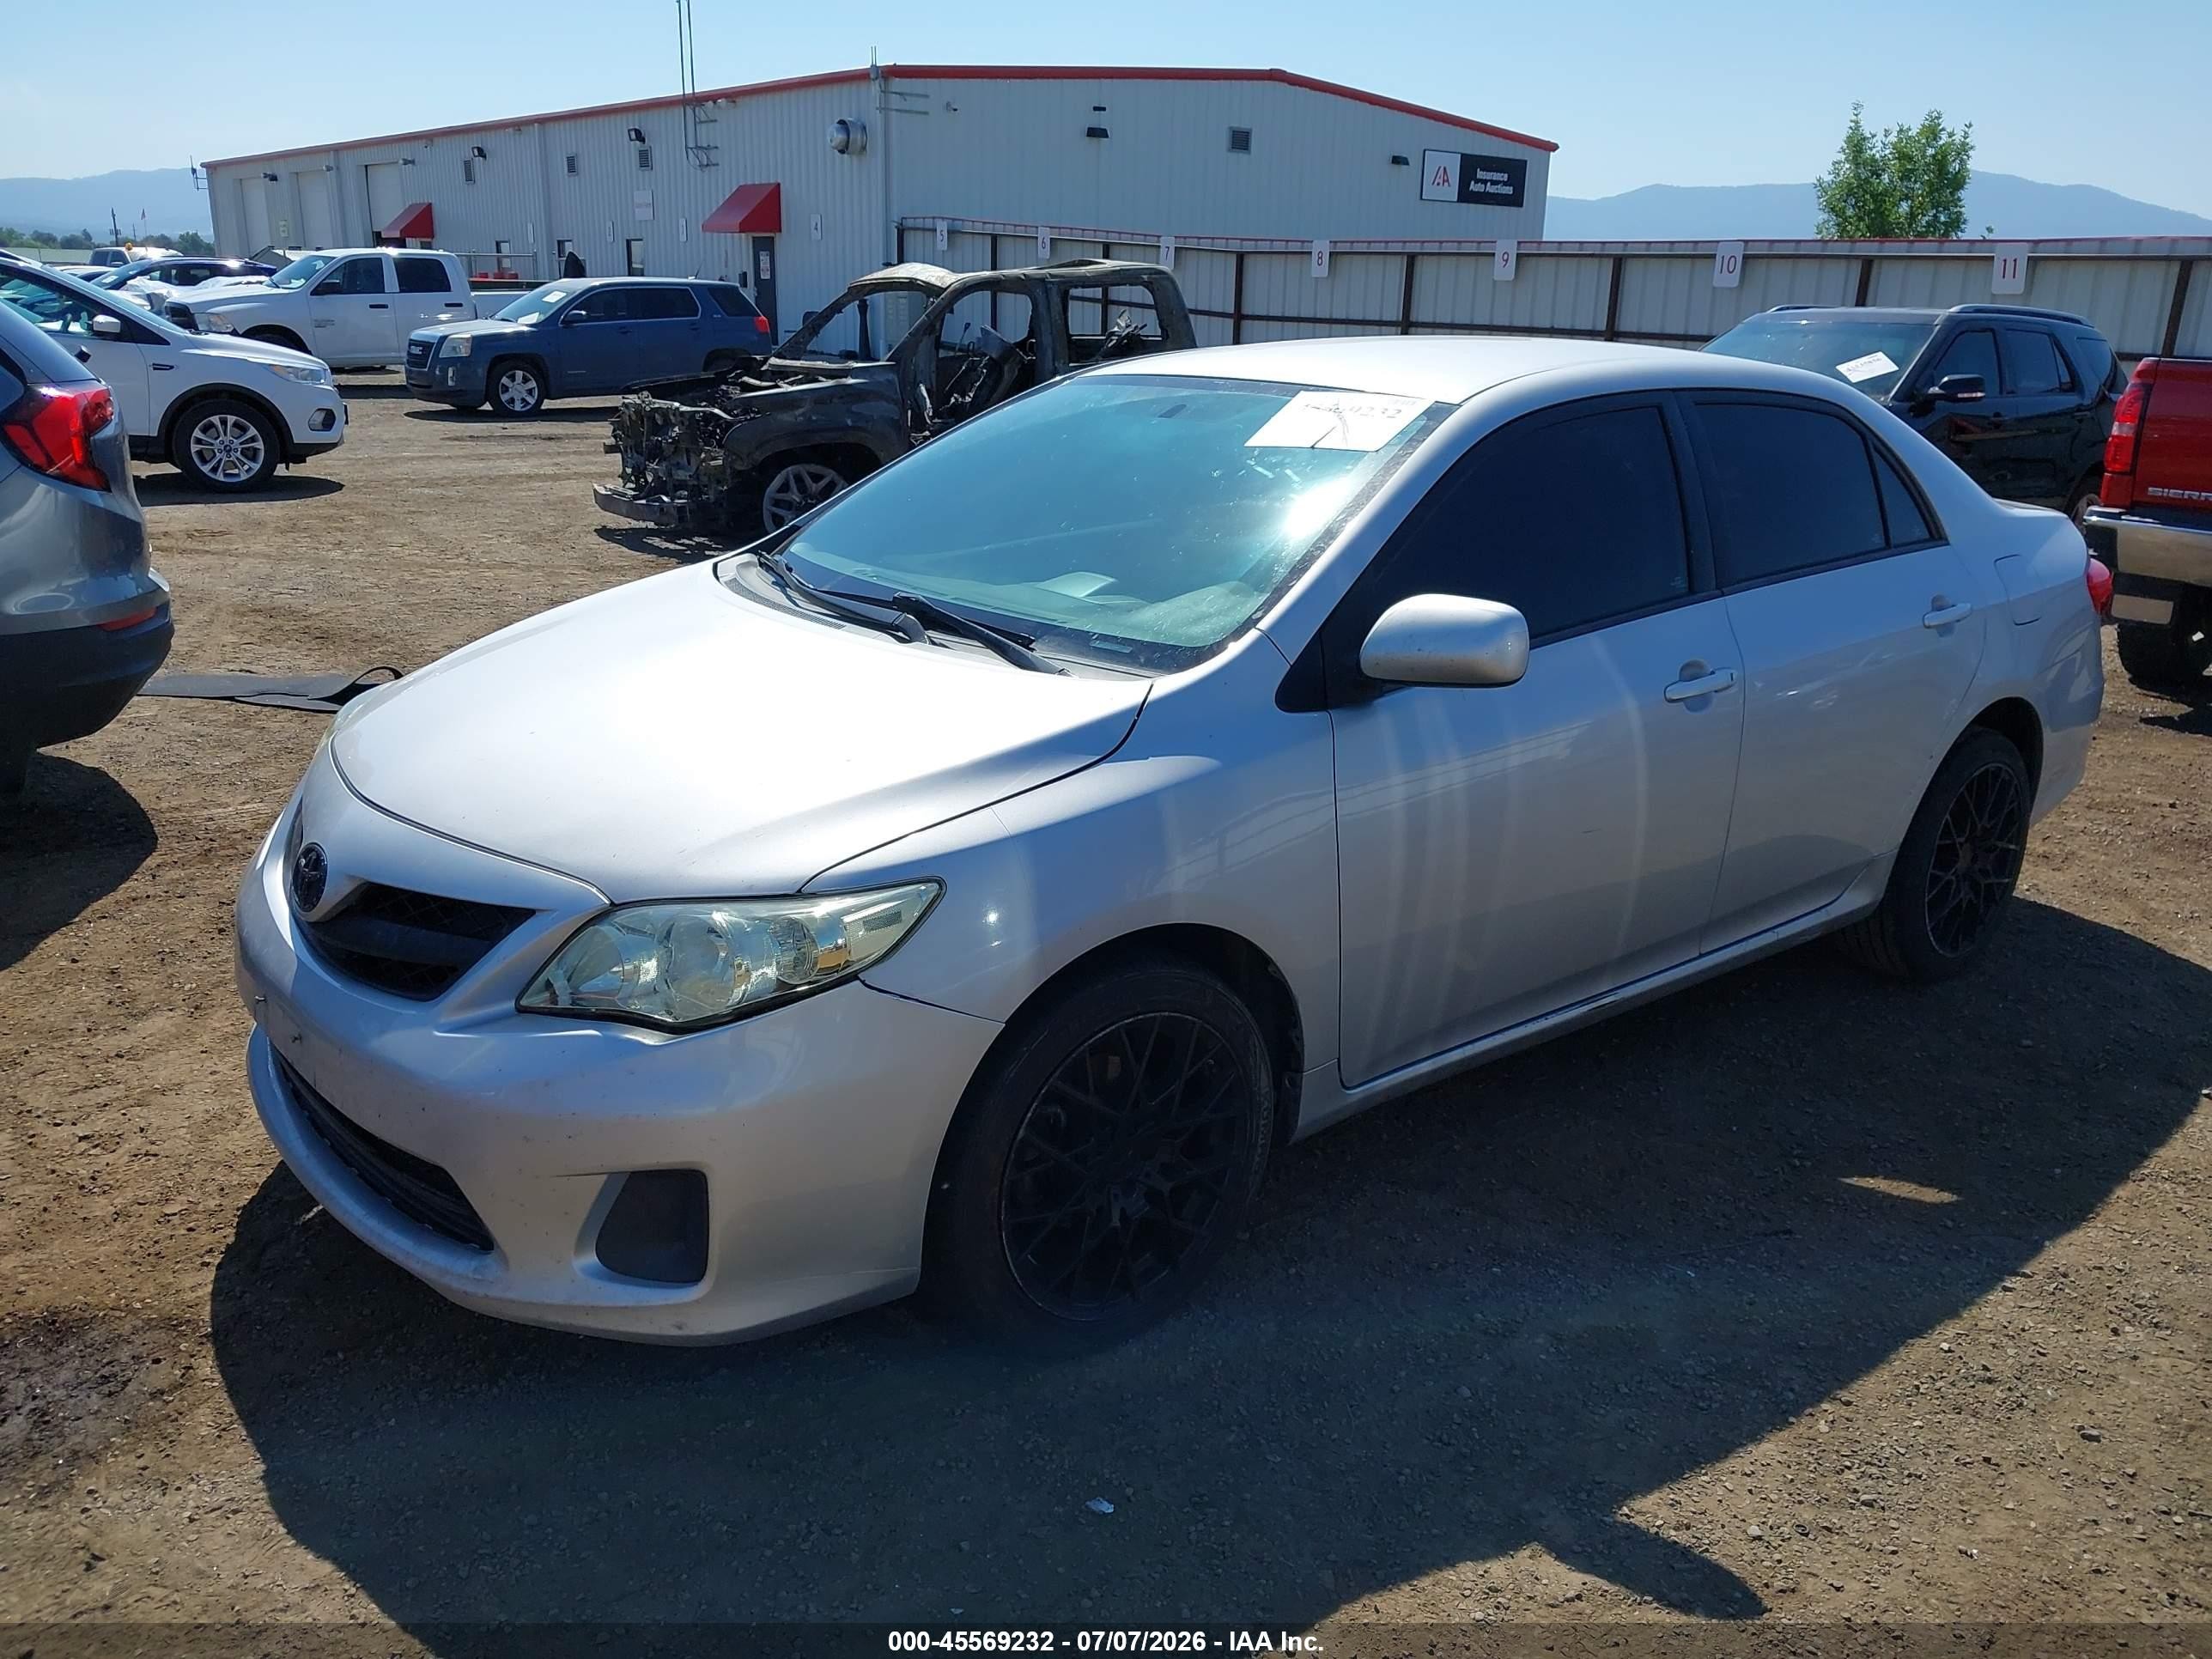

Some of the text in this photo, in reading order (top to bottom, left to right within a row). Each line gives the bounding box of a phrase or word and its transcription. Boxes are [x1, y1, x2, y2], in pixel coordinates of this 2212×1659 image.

[1477, 168, 1509, 181] Insurance
[1469, 180, 1514, 195] Auto Auctions
[813, 222, 818, 234] 4
[939, 229, 945, 242] 5
[1041, 237, 1047, 249] 6
[1164, 246, 1170, 260] 7
[1317, 250, 1323, 266] 8
[1502, 251, 1510, 268] 9
[1719, 254, 1737, 274] 10
[2002, 258, 2017, 279] 11
